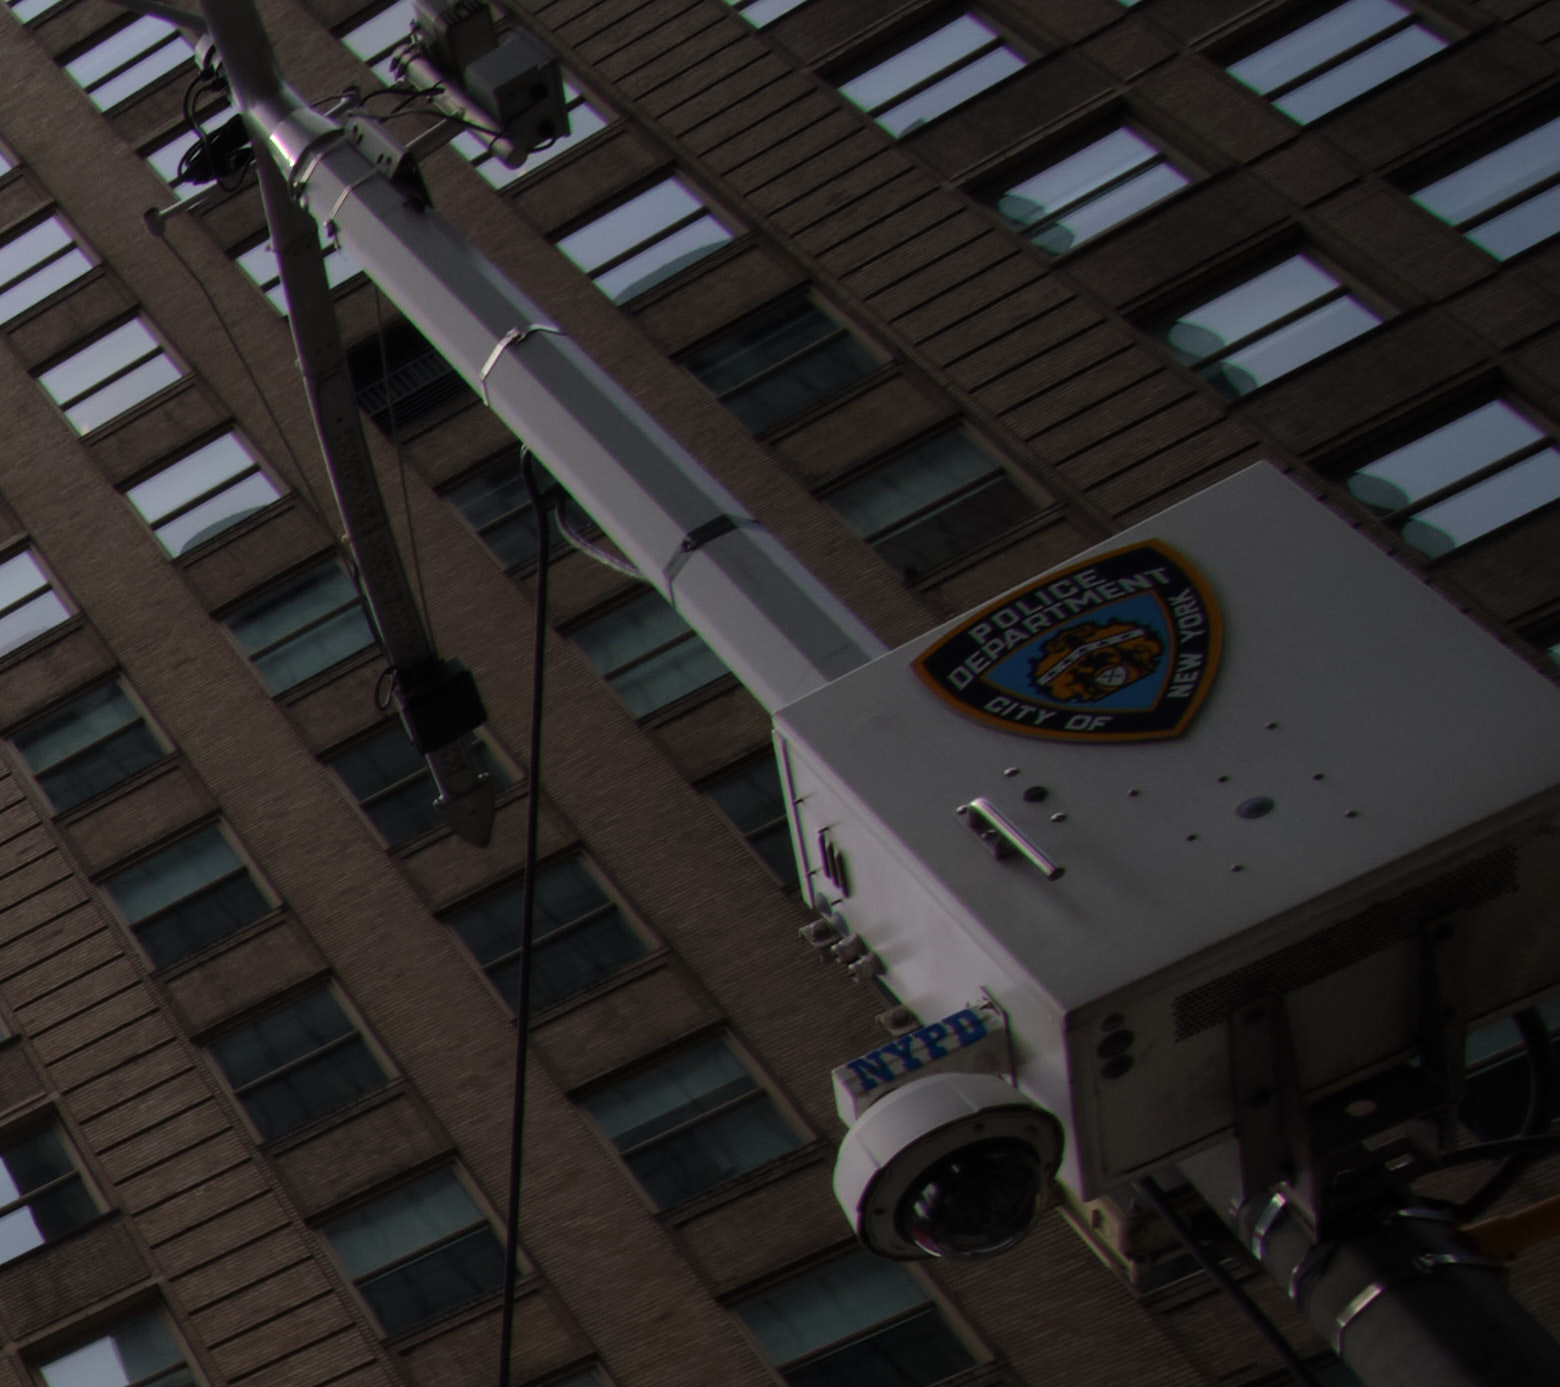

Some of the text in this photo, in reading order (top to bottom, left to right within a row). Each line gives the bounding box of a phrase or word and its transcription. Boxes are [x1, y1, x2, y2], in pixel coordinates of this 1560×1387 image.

[946, 566, 1170, 692] DEPARTMENT
[968, 568, 1107, 646] POLICE
[1166, 586, 1206, 699] NEW YORK
[982, 695, 1115, 732] CITY OF
[847, 1008, 987, 1091] NYPD
